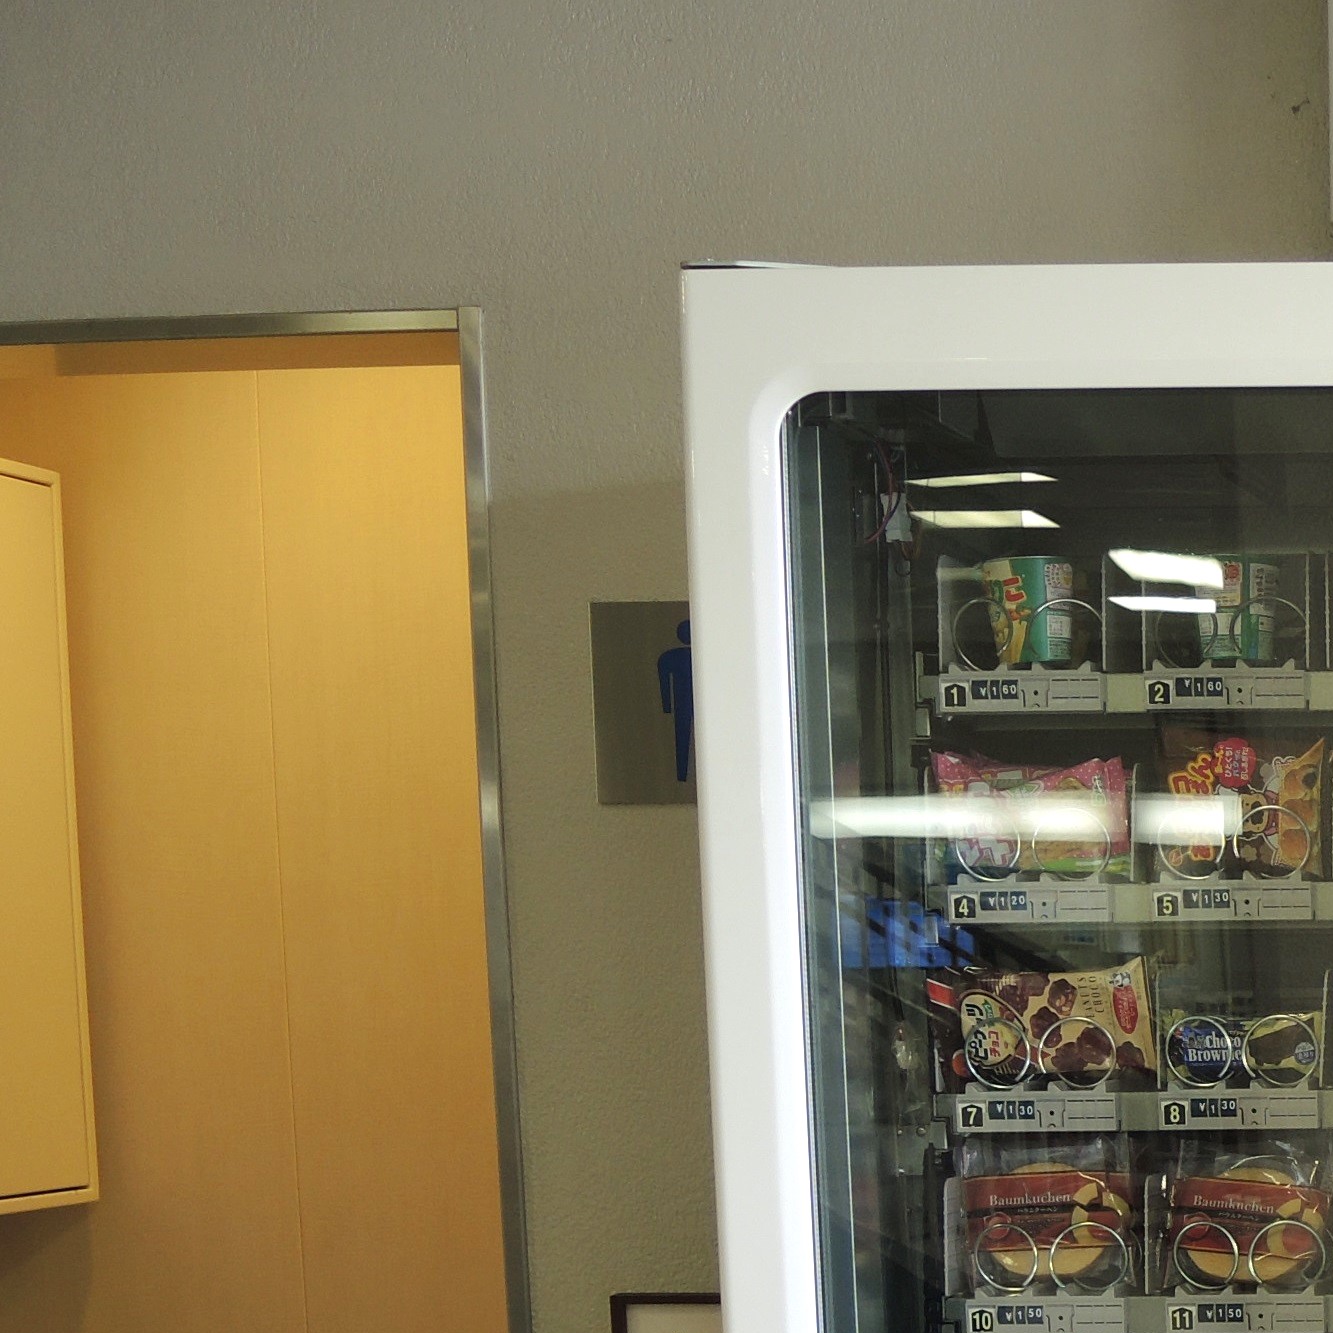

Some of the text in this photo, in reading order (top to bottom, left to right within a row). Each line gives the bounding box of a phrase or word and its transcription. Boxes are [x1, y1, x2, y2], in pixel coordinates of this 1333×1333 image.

[950, 684, 960, 705] 1
[1154, 682, 1164, 702] 2
[959, 897, 969, 917] 4
[1163, 895, 1173, 915] 5
[1206, 1035, 1241, 1049] Choco
[967, 1106, 977, 1124] 7
[1170, 1104, 1180, 1123] 8
[989, 1193, 1071, 1206] Baumkuchen
[1194, 1195, 1274, 1215] Baumkuchen
[972, 1311, 992, 1331] 10
[1172, 1310, 1191, 1330] 11
